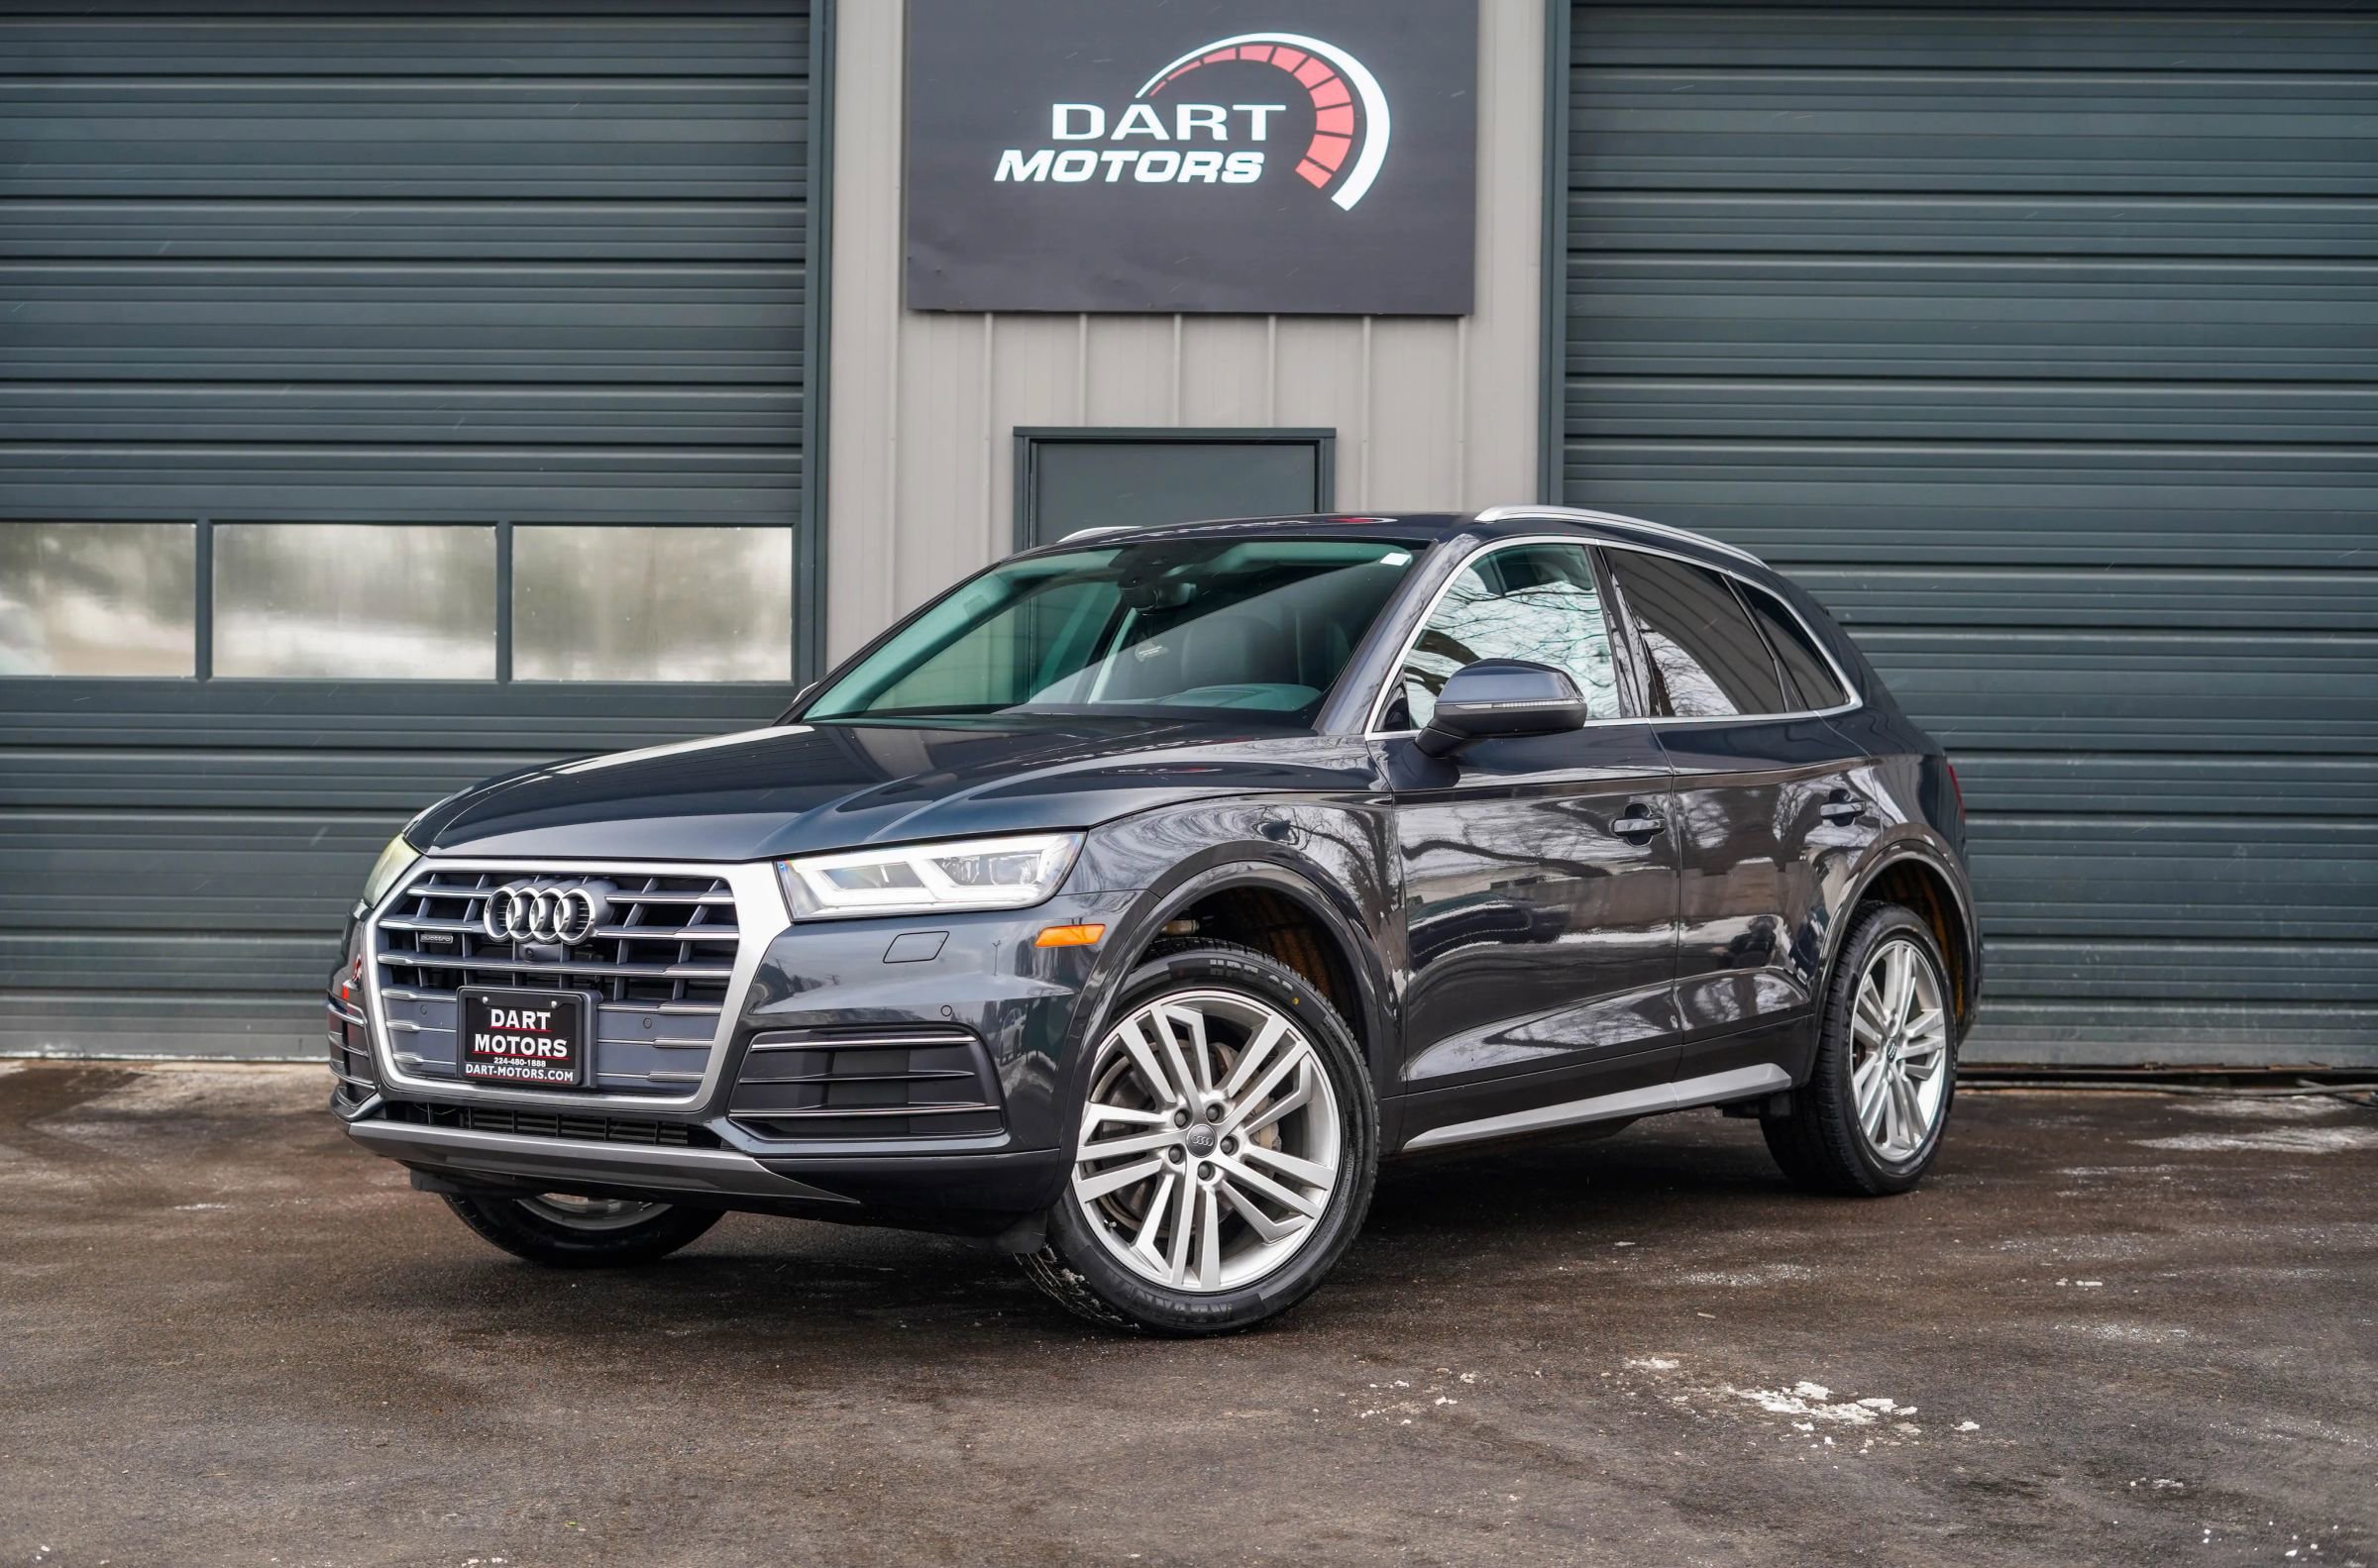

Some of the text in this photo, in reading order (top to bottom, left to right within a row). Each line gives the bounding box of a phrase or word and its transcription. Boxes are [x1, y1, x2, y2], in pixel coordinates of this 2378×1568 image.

[1052, 104, 1286, 141] DART
[994, 150, 1264, 183] MOTORS
[490, 1008, 551, 1030] DART
[475, 1033, 568, 1057] MOTORS
[466, 1063, 574, 1082] DART-MOTORS.COM
[493, 1057, 546, 1067] 224-480-1888
